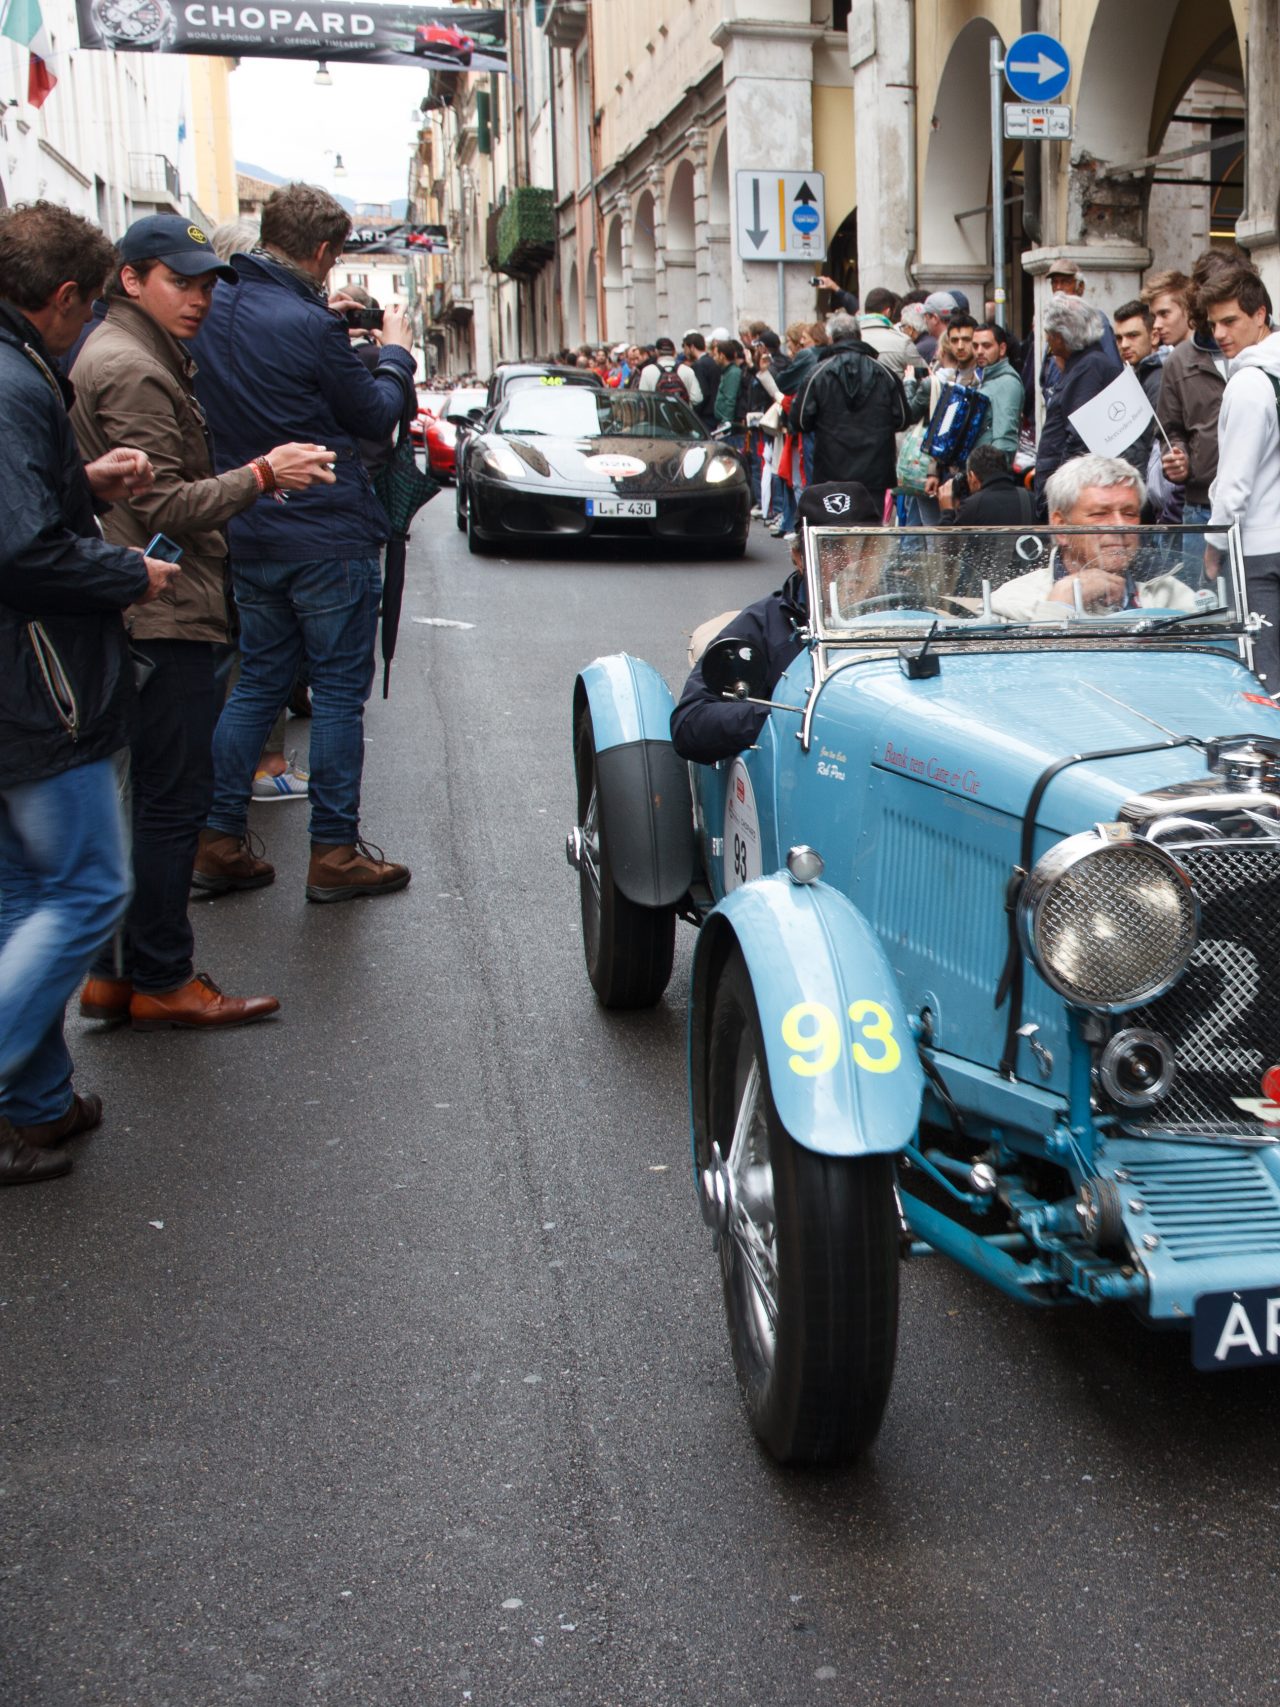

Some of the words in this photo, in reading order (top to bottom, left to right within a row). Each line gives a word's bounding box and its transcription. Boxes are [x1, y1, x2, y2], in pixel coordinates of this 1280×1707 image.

[184, 3, 375, 36] CHOPARD
[186, 31, 218, 40] WORLD
[220, 33, 262, 43] SPONSOR
[284, 37, 321, 47] OFFICIAL
[325, 39, 376, 49] TIMEKEEPER
[1021, 107, 1055, 115] eccetto
[348, 229, 388, 242] ARD
[628, 502, 652, 516] 430
[884, 741, 909, 769] Bank
[961, 770, 982, 795] Cie
[734, 832, 747, 884] 93
[781, 998, 902, 1077] 93
